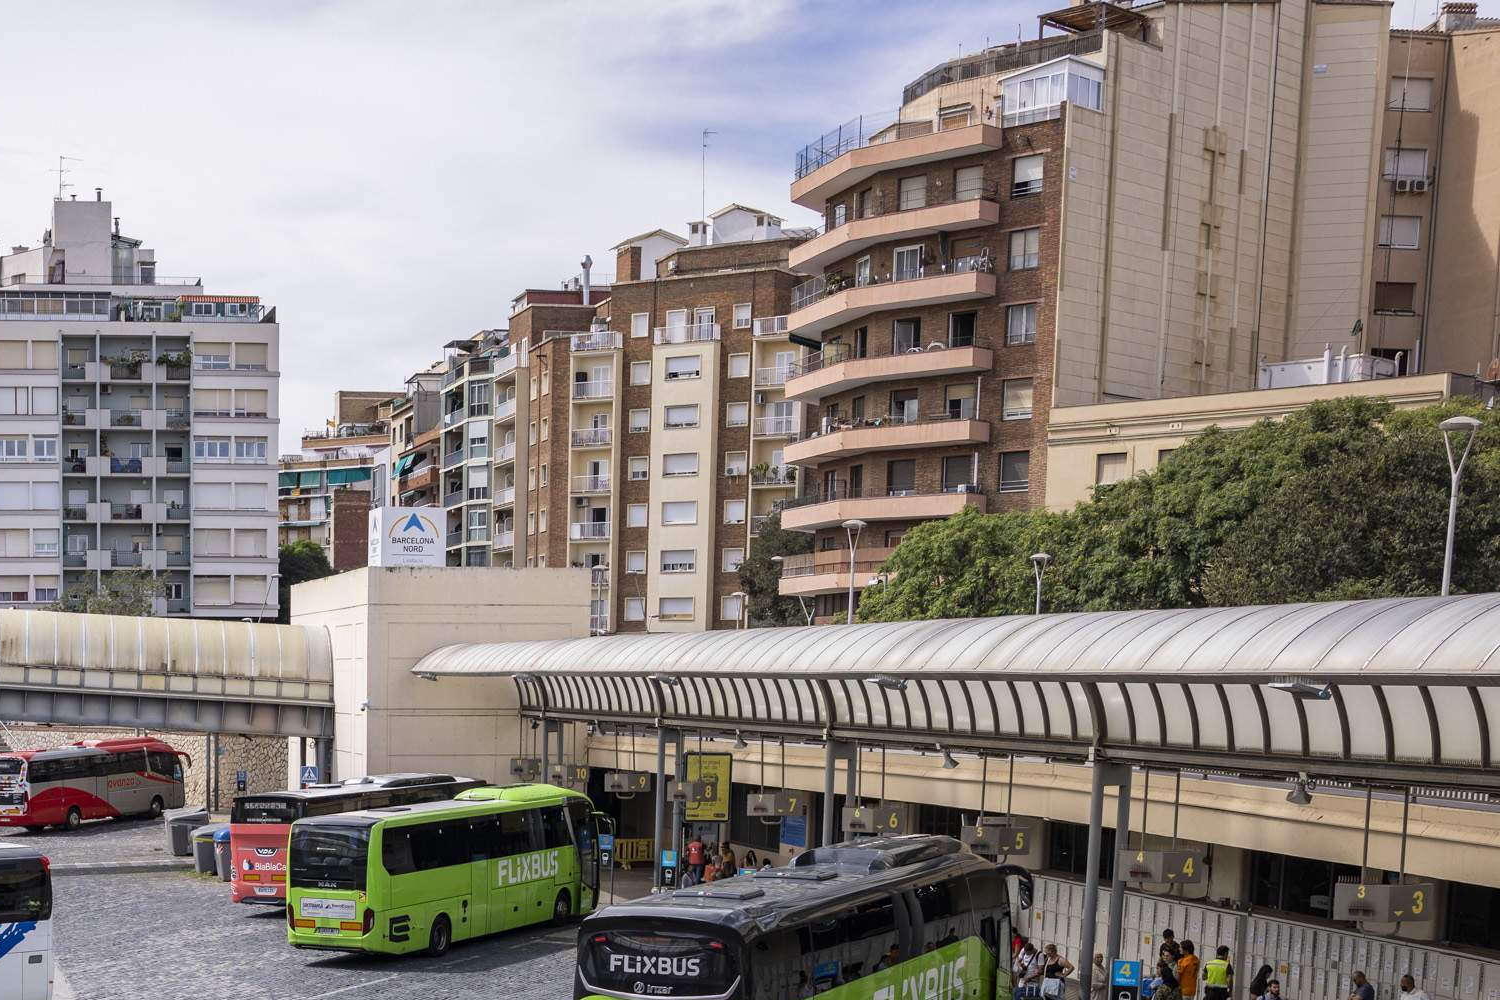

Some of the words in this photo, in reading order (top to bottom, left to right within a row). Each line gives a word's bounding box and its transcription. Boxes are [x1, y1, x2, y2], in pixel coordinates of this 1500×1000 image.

[391, 536, 435, 545] BARCELONA
[403, 545, 424, 553] NORD
[576, 767, 587, 780] 10
[639, 776, 646, 789] 9
[704, 785, 712, 798] 8
[788, 798, 797, 813] 7
[976, 827, 984, 838] 5
[1015, 832, 1025, 850] 5
[1136, 851, 1144, 864] 4
[1182, 857, 1194, 878] 4
[1356, 885, 1366, 899] 3
[1411, 890, 1424, 914] 3
[1119, 963, 1132, 977] 4
